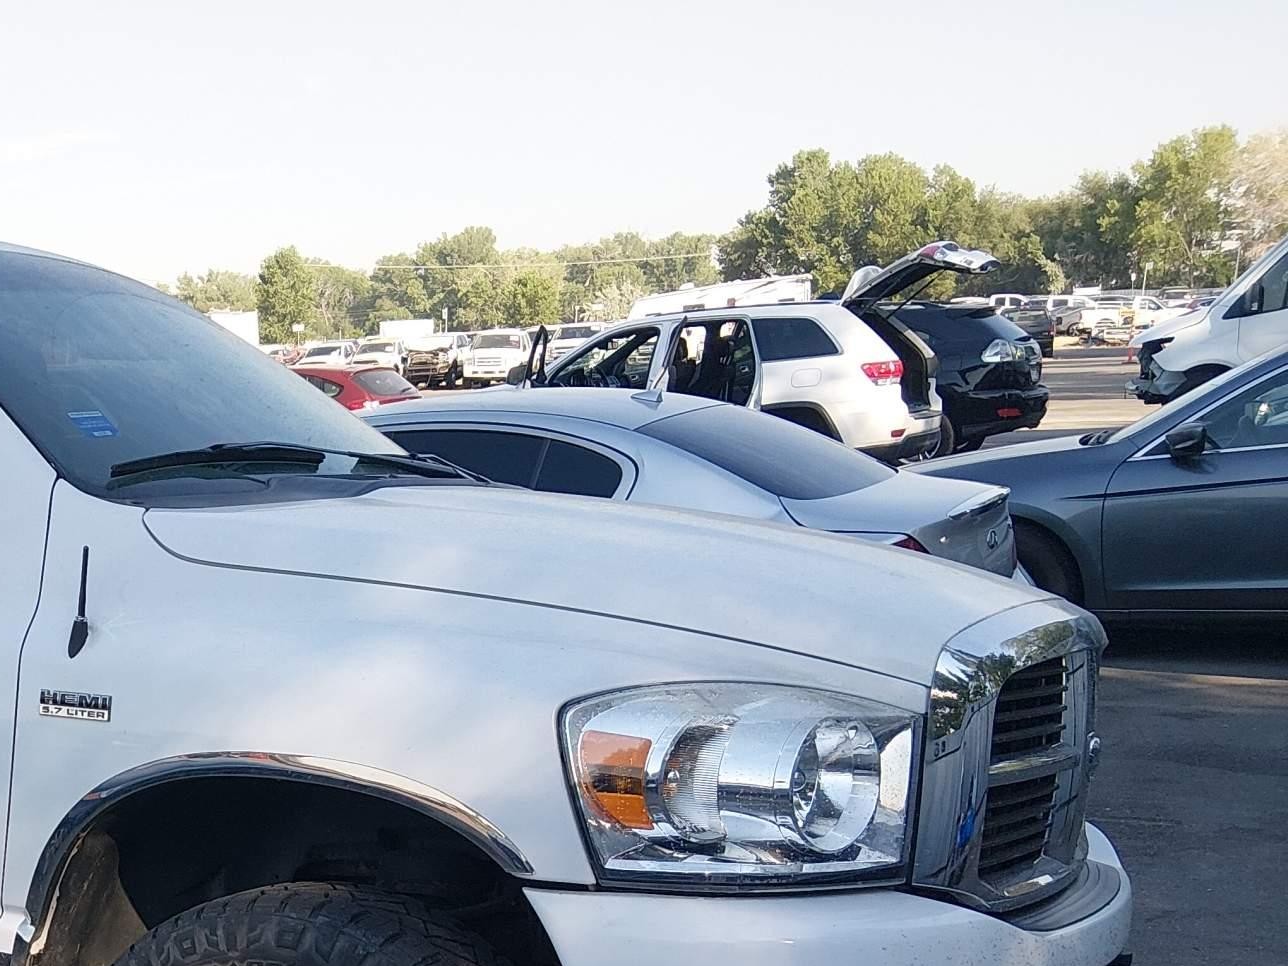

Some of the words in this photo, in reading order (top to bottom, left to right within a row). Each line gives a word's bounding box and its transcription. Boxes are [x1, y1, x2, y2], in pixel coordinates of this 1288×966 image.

[40, 689, 112, 710] HEMI
[41, 706, 63, 717] 5.7
[66, 707, 106, 721] LITER
